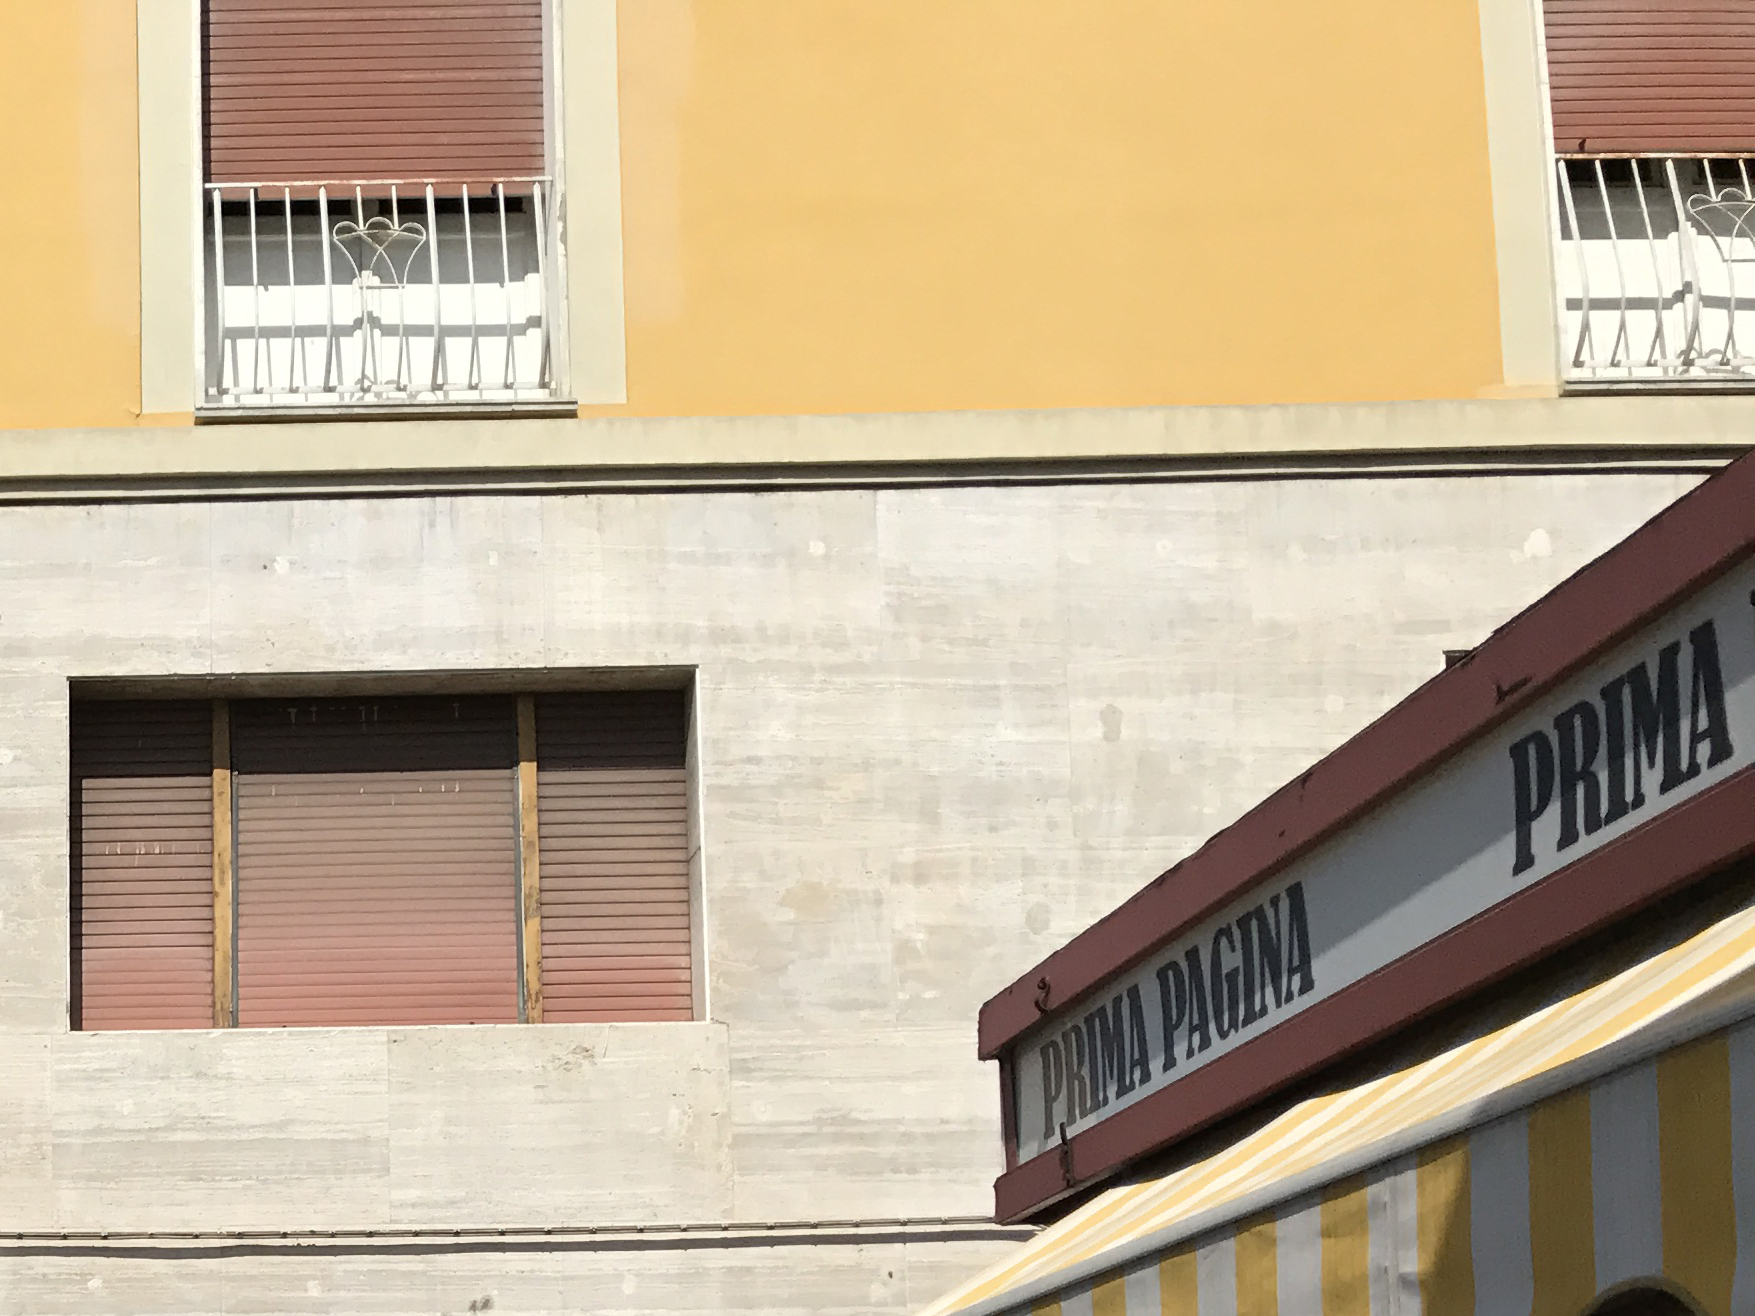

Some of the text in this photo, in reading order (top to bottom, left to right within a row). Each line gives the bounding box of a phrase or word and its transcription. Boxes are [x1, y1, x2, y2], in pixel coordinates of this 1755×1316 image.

[1508, 618, 1735, 877] PRIMA
[1040, 882, 1315, 1141] PRIMA PAGINA
